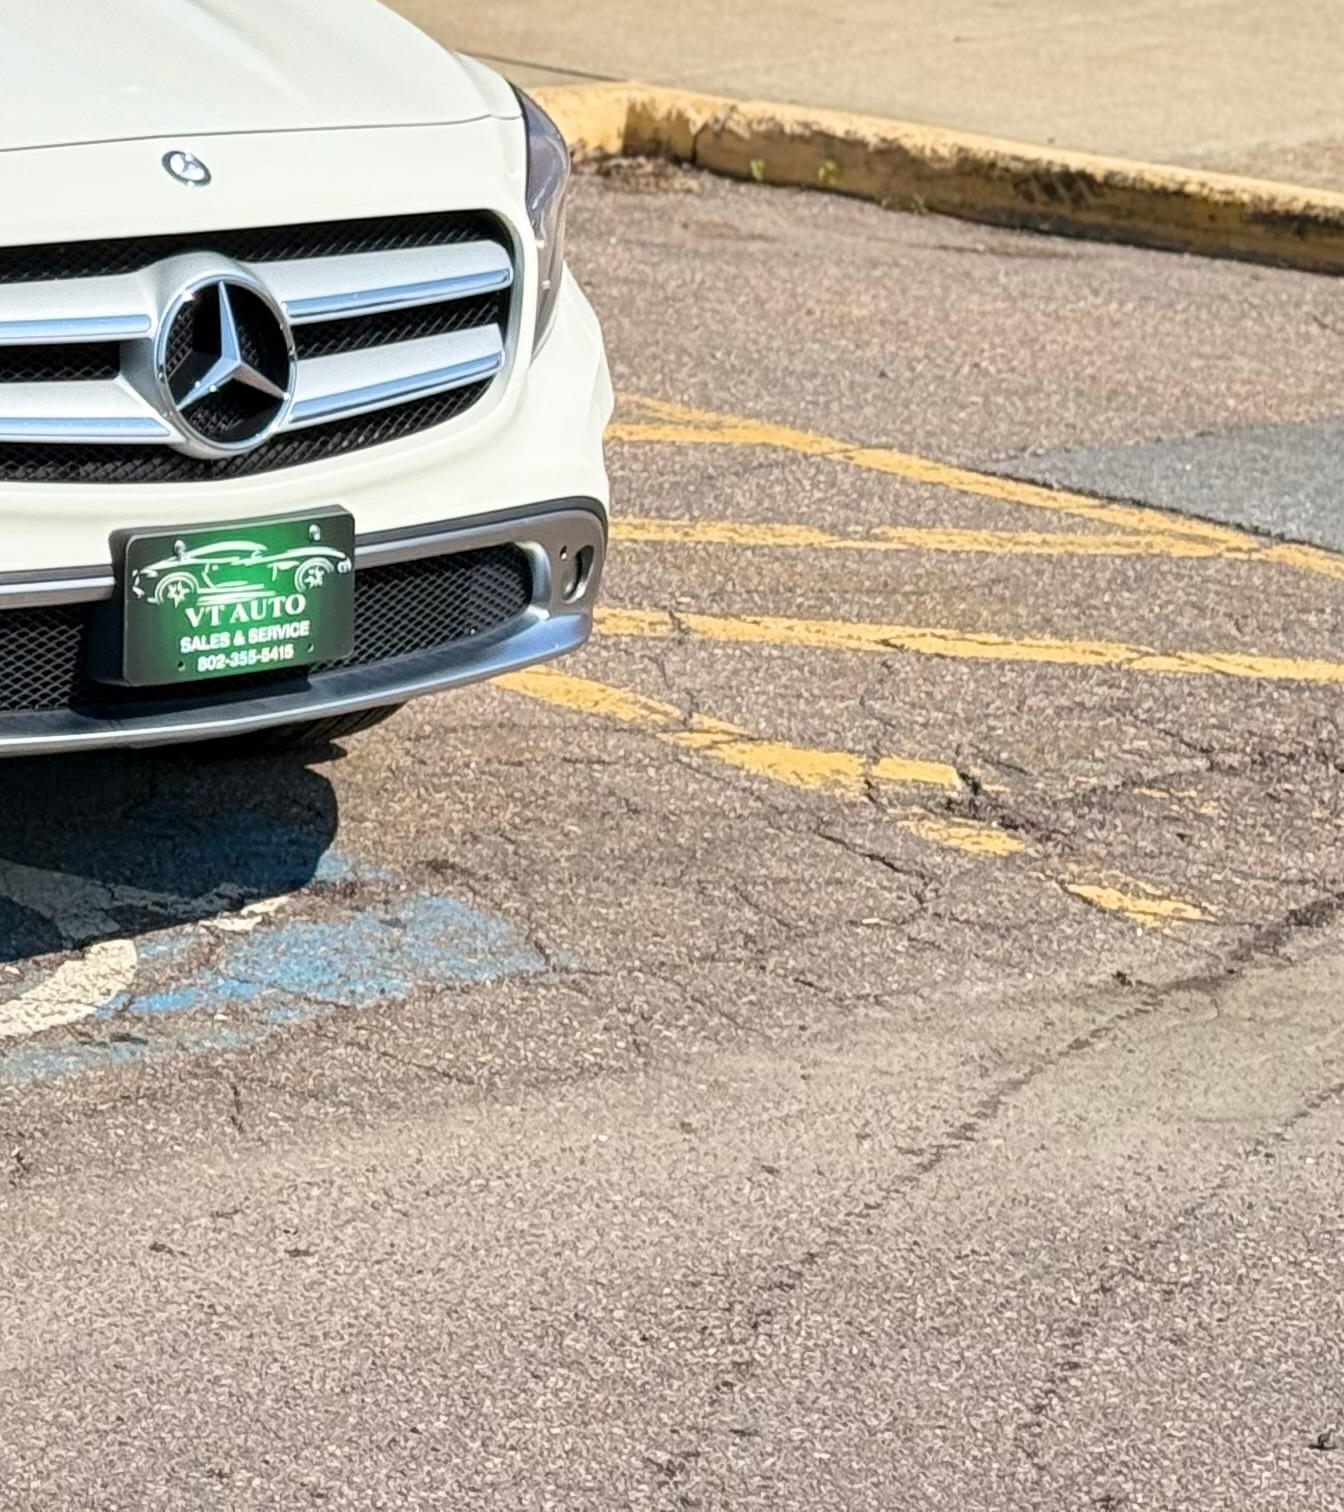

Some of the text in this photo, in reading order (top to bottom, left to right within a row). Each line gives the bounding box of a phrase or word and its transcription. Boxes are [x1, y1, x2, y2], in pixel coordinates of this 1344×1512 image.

[185, 593, 306, 628] VT AUTO
[180, 620, 310, 653] SALES & SERVICE
